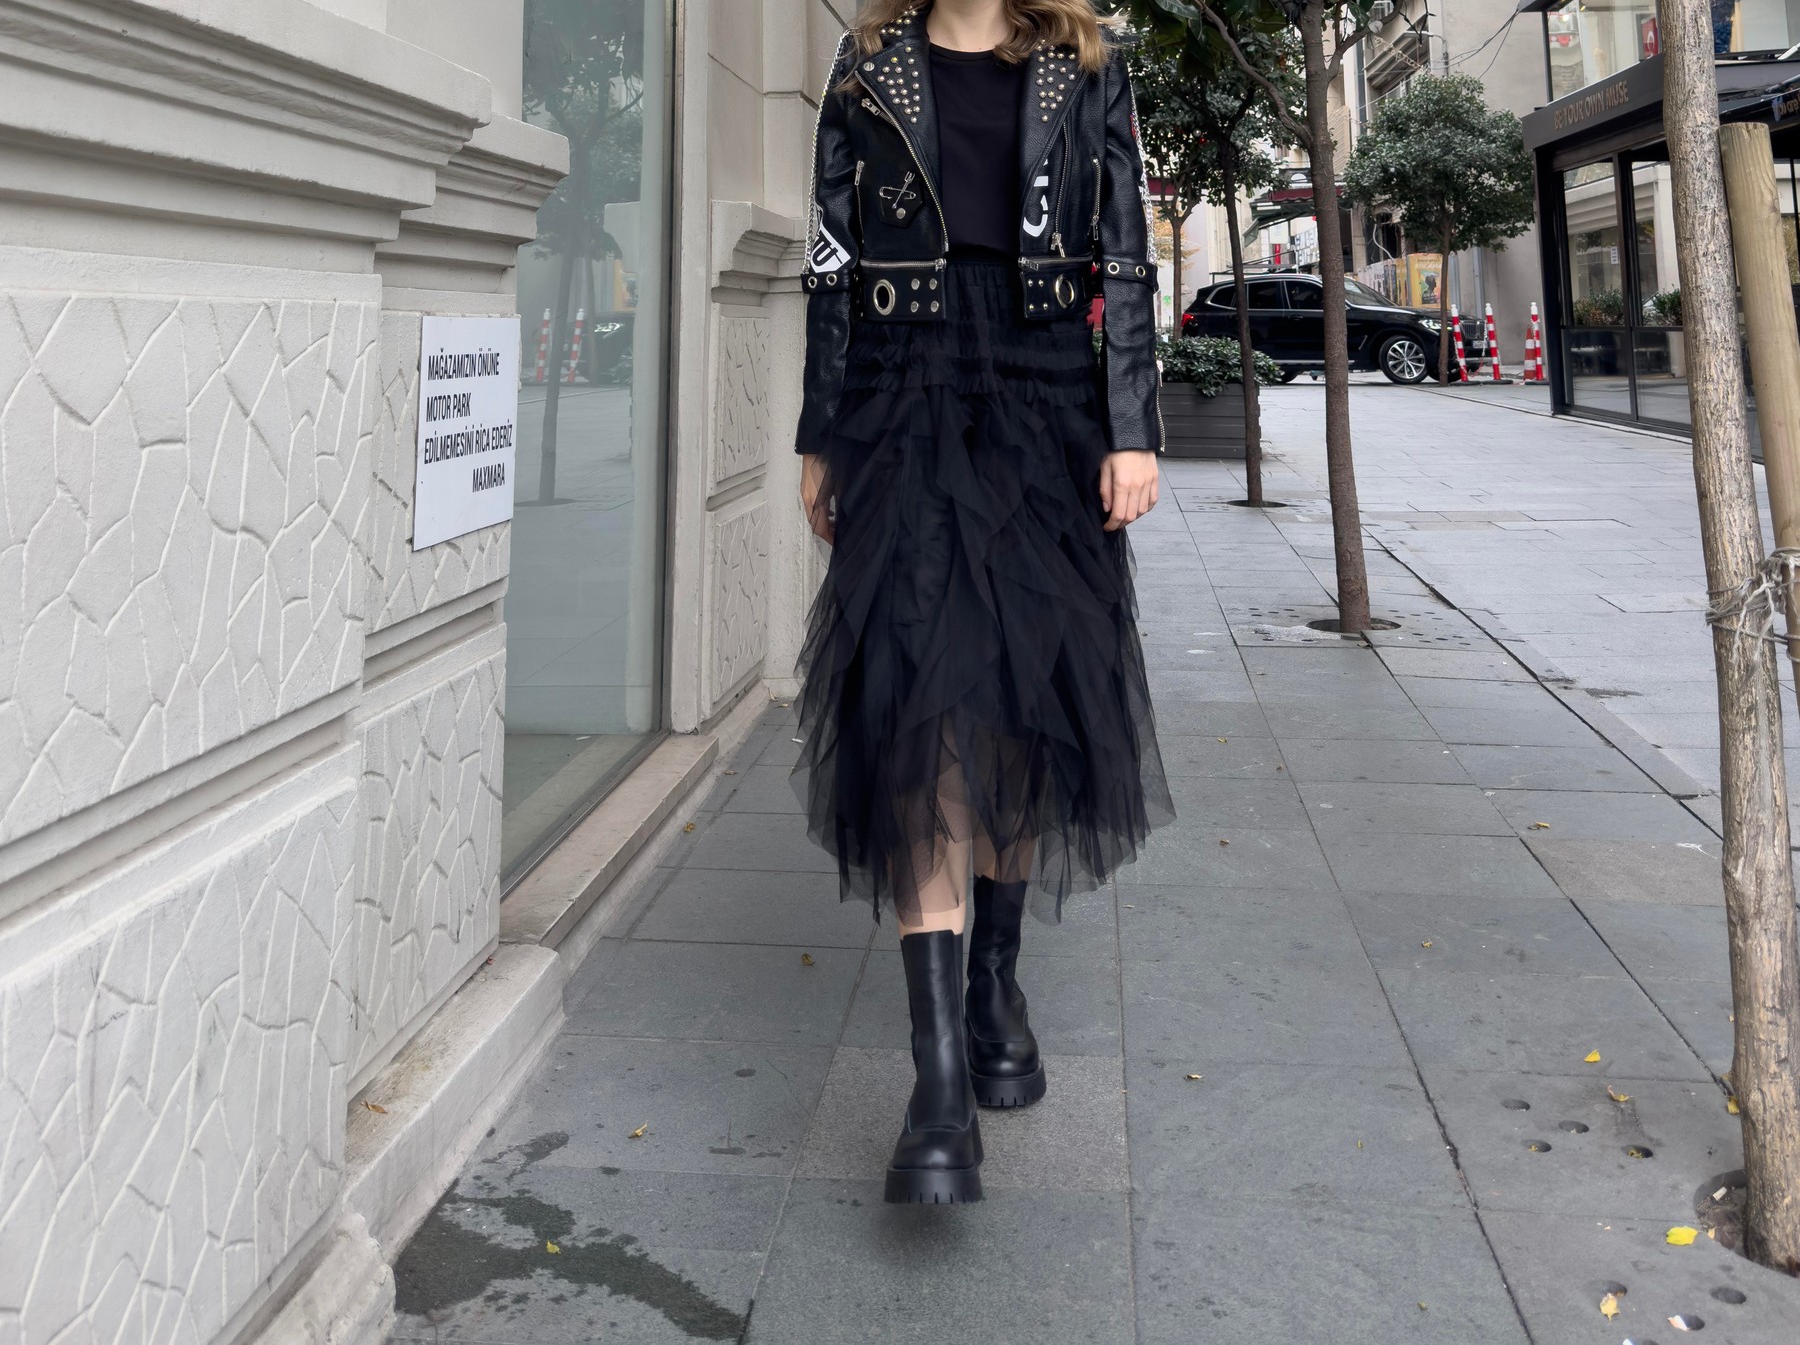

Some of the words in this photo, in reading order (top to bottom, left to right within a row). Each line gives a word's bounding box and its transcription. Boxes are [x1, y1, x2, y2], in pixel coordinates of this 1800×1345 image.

[1554, 110, 1563, 130] BE
[1563, 101, 1584, 126] YOUR
[1584, 92, 1605, 117] OWN
[1605, 80, 1629, 110] MUSE
[428, 347, 477, 381] MAĞAZAMIZIN
[477, 347, 500, 377] ÖNÜNE
[426, 394, 452, 423] MOTOR
[452, 392, 472, 418] PARK
[424, 424, 475, 465] EDİLMEMESİNİ
[475, 423, 490, 454] RİCA
[491, 419, 513, 451] EDERİZ
[472, 462, 505, 493] MAXMARA
